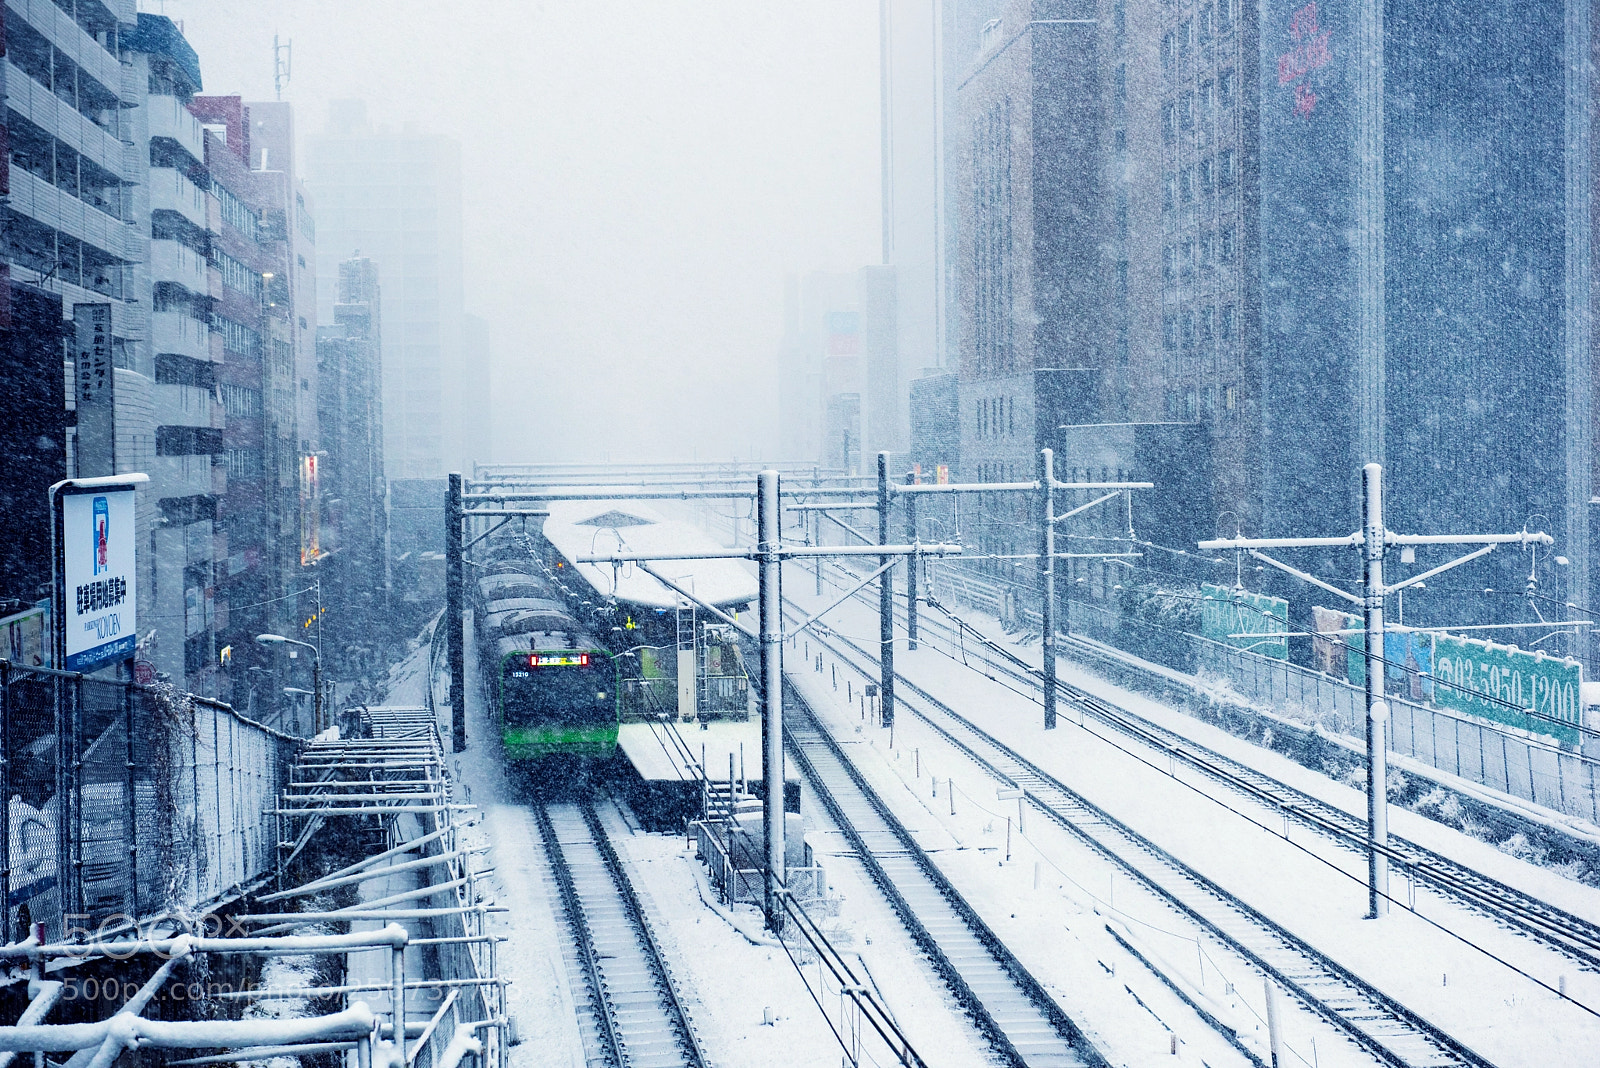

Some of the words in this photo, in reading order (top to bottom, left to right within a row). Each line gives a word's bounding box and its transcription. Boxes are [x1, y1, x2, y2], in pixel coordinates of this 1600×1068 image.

[76, 575, 127, 616] 駐車場用地募集中
